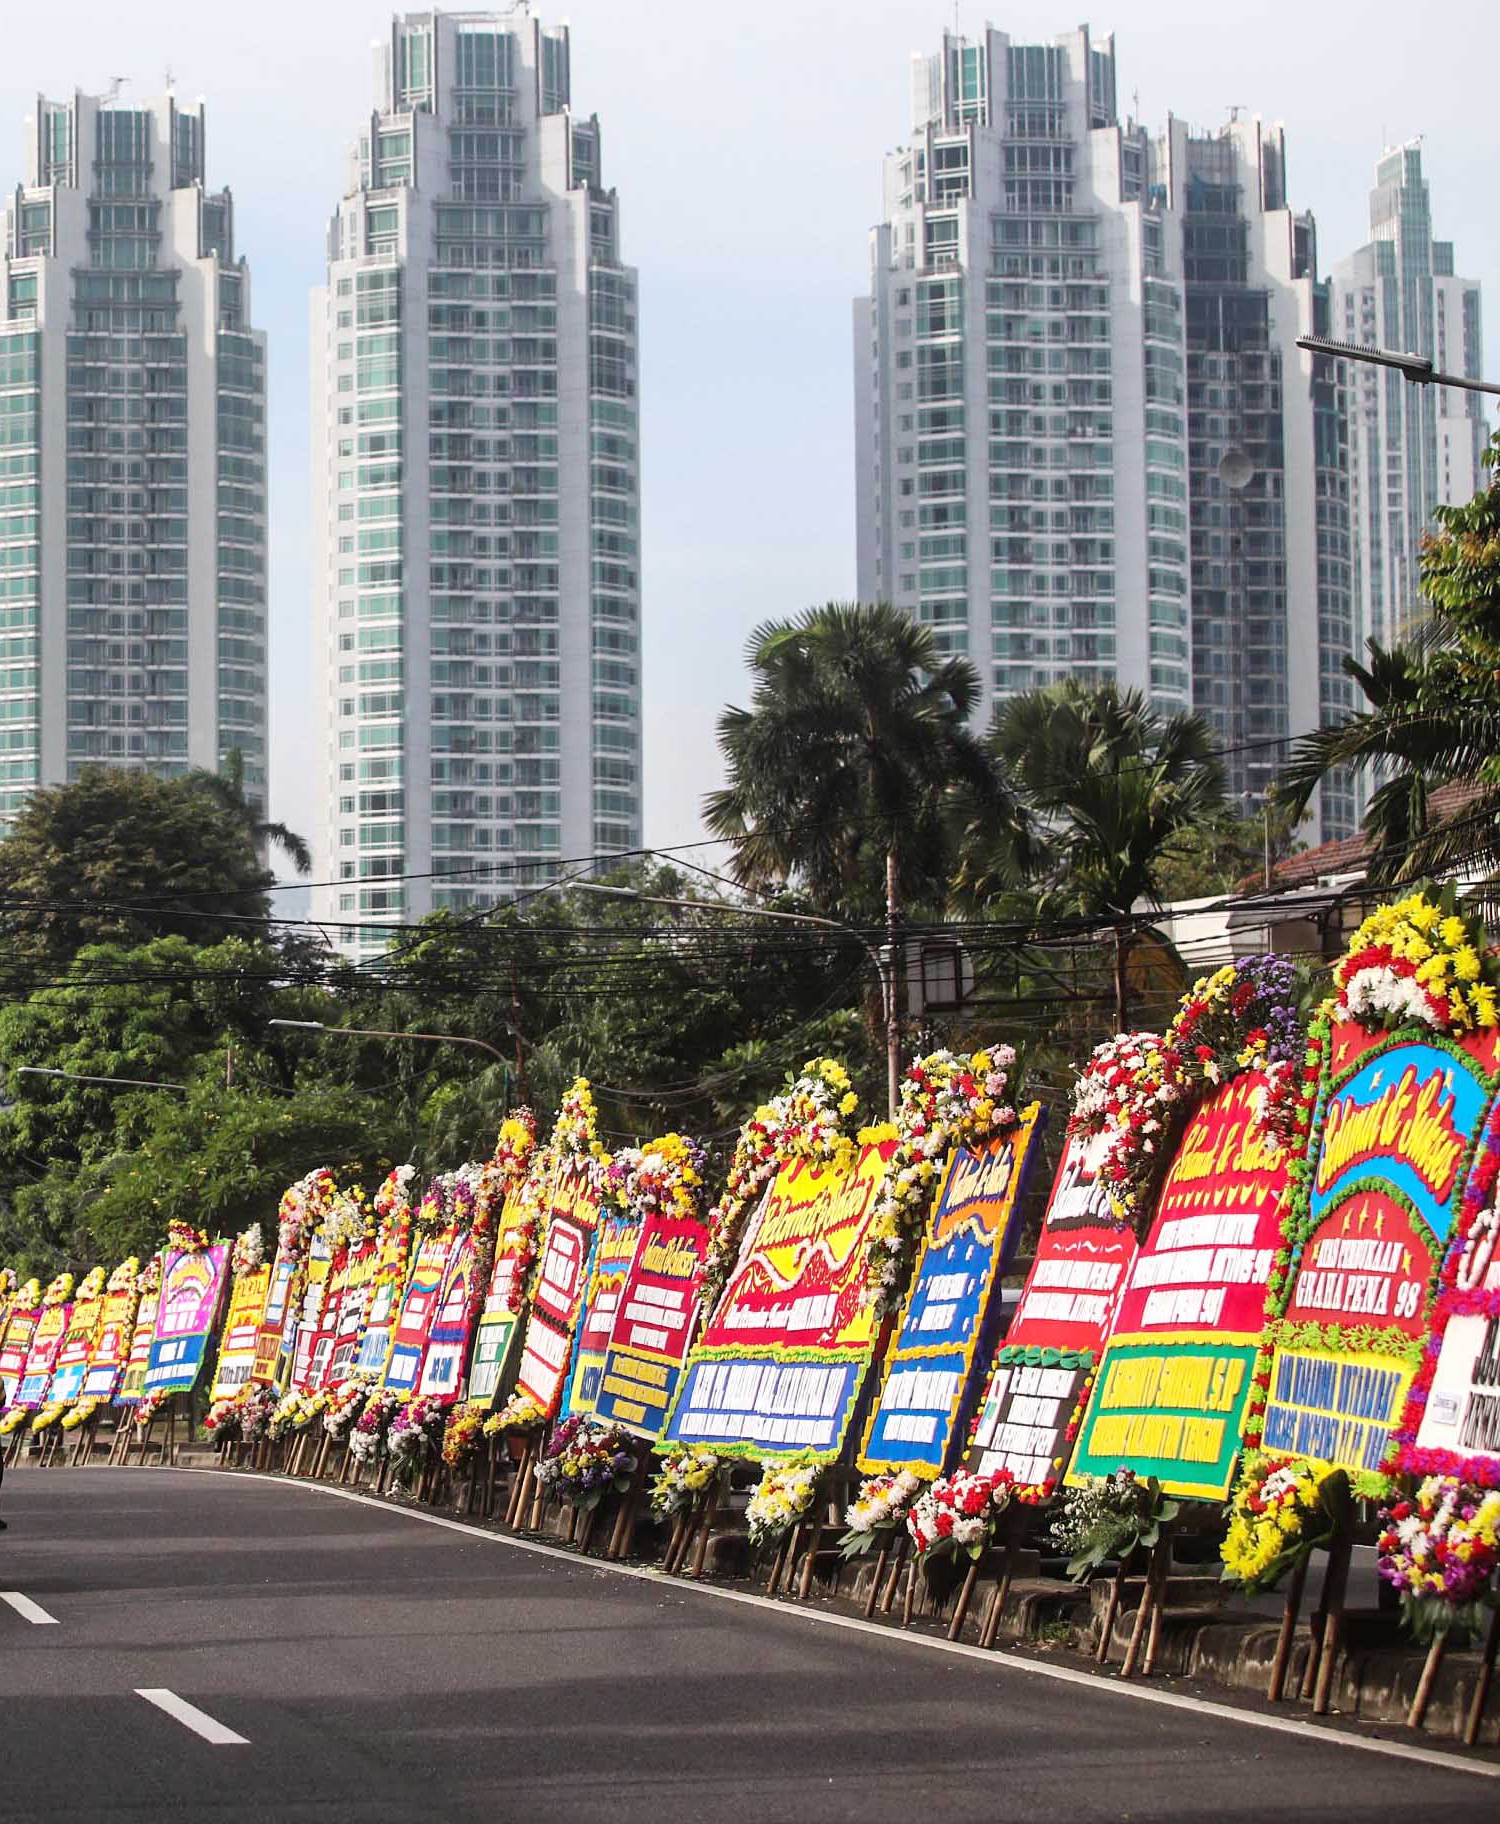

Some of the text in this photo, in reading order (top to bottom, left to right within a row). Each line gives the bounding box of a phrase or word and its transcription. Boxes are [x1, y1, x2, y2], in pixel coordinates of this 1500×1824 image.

[1295, 1271, 1421, 1319] GRAHA PENA 98
